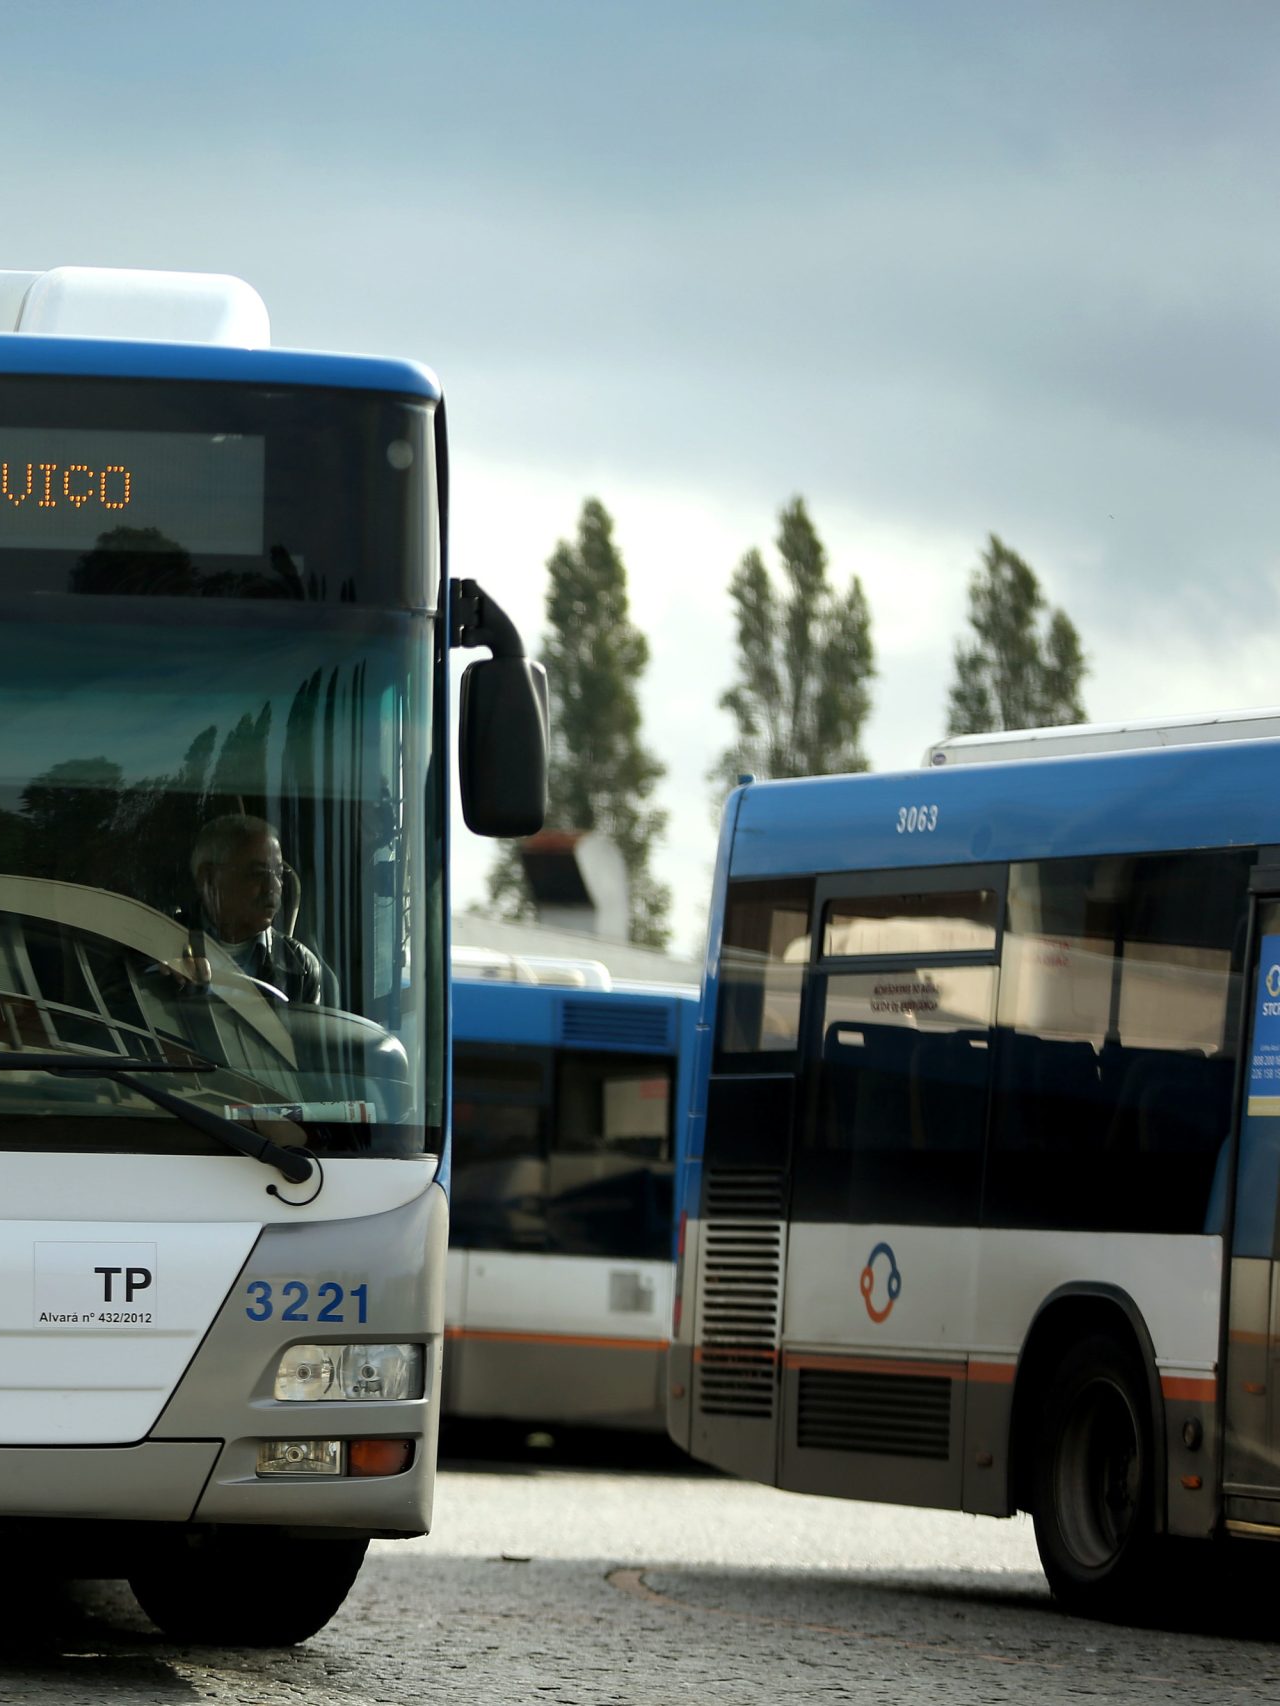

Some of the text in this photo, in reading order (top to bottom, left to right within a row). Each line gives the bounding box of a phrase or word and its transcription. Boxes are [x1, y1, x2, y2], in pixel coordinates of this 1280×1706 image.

[895, 804, 939, 834] 3063
[94, 1267, 152, 1303] TP
[39, 1312, 79, 1323] Alvará
[99, 1312, 152, 1323] 432/2012
[245, 1281, 369, 1324] 3221
